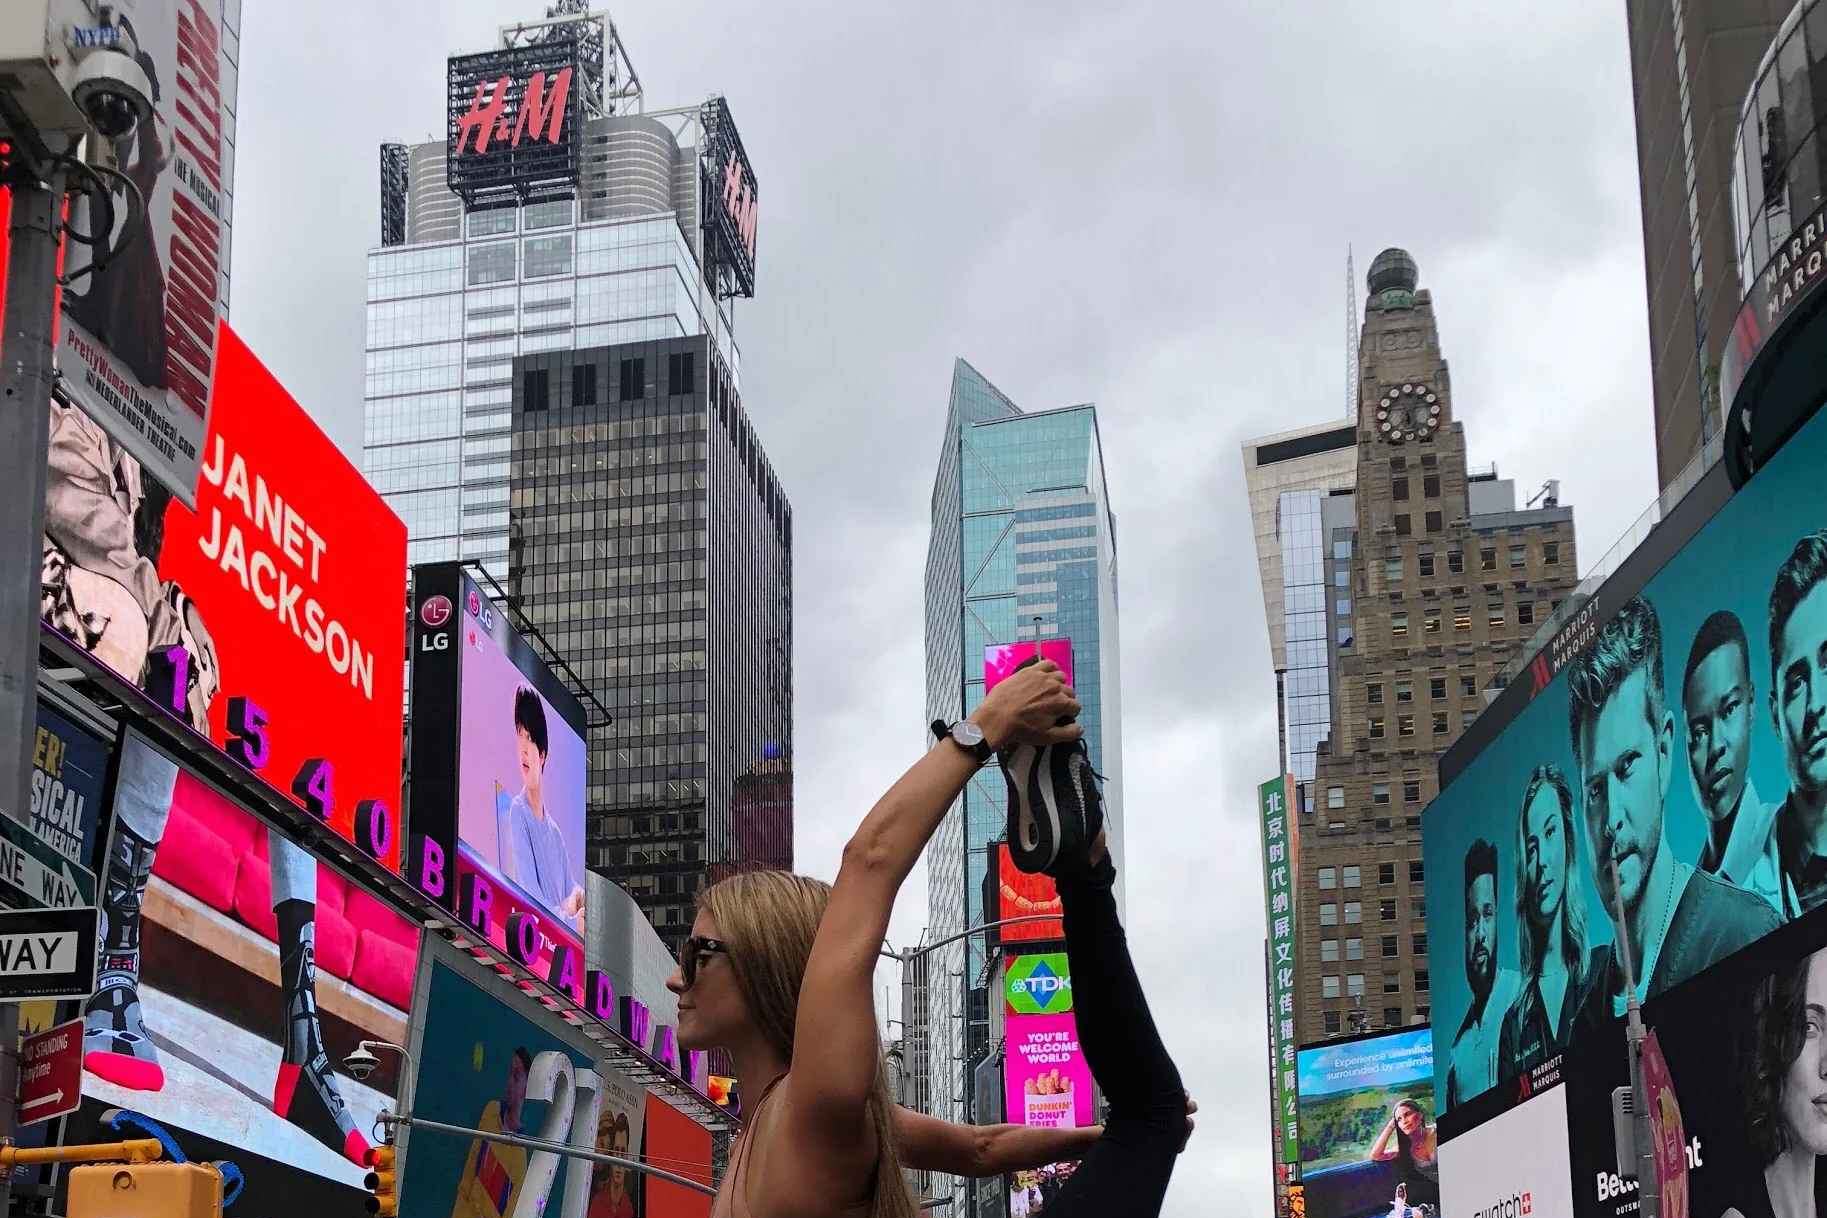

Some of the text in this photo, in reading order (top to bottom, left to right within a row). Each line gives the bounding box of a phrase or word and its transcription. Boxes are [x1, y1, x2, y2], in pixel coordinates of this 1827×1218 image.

[456, 67, 573, 154] H&M
[174, 157, 220, 219] THE MUSICAL
[723, 150, 758, 261] H&M
[1766, 213, 1825, 293] MARRI
[165, 187, 220, 421] WOMAN
[95, 379, 177, 463] NEDERLANDER THEATRE
[201, 433, 328, 583] JANET
[198, 506, 374, 701] JACKSON
[480, 601, 492, 630] LG
[1552, 596, 1600, 655] MARRIOTT
[422, 632, 449, 652] LG
[1554, 622, 1596, 673] MARQUIS
[34, 727, 66, 778] ER!
[166, 644, 701, 1085] 1540 BROADWAY
[42, 872, 77, 908] WAY
[1025, 976, 1073, 993] TDK
[35, 1033, 69, 1059] STANDING
[1019, 1042, 1079, 1054] WELCOME
[1027, 1032, 1069, 1044] YOU'RE
[1027, 1053, 1071, 1064] WORLD
[1334, 1043, 1433, 1068] Experience unlimited
[1532, 1054, 1563, 1078] MARRIOTT
[23, 1061, 51, 1086] Anytime
[1326, 1064, 1380, 1080] surrounded
[1382, 1062, 1393, 1073] by
[1533, 1070, 1561, 1090] MARQUIS
[1029, 1101, 1073, 1111] DUNKIN'
[1029, 1111, 1066, 1120] DONUT
